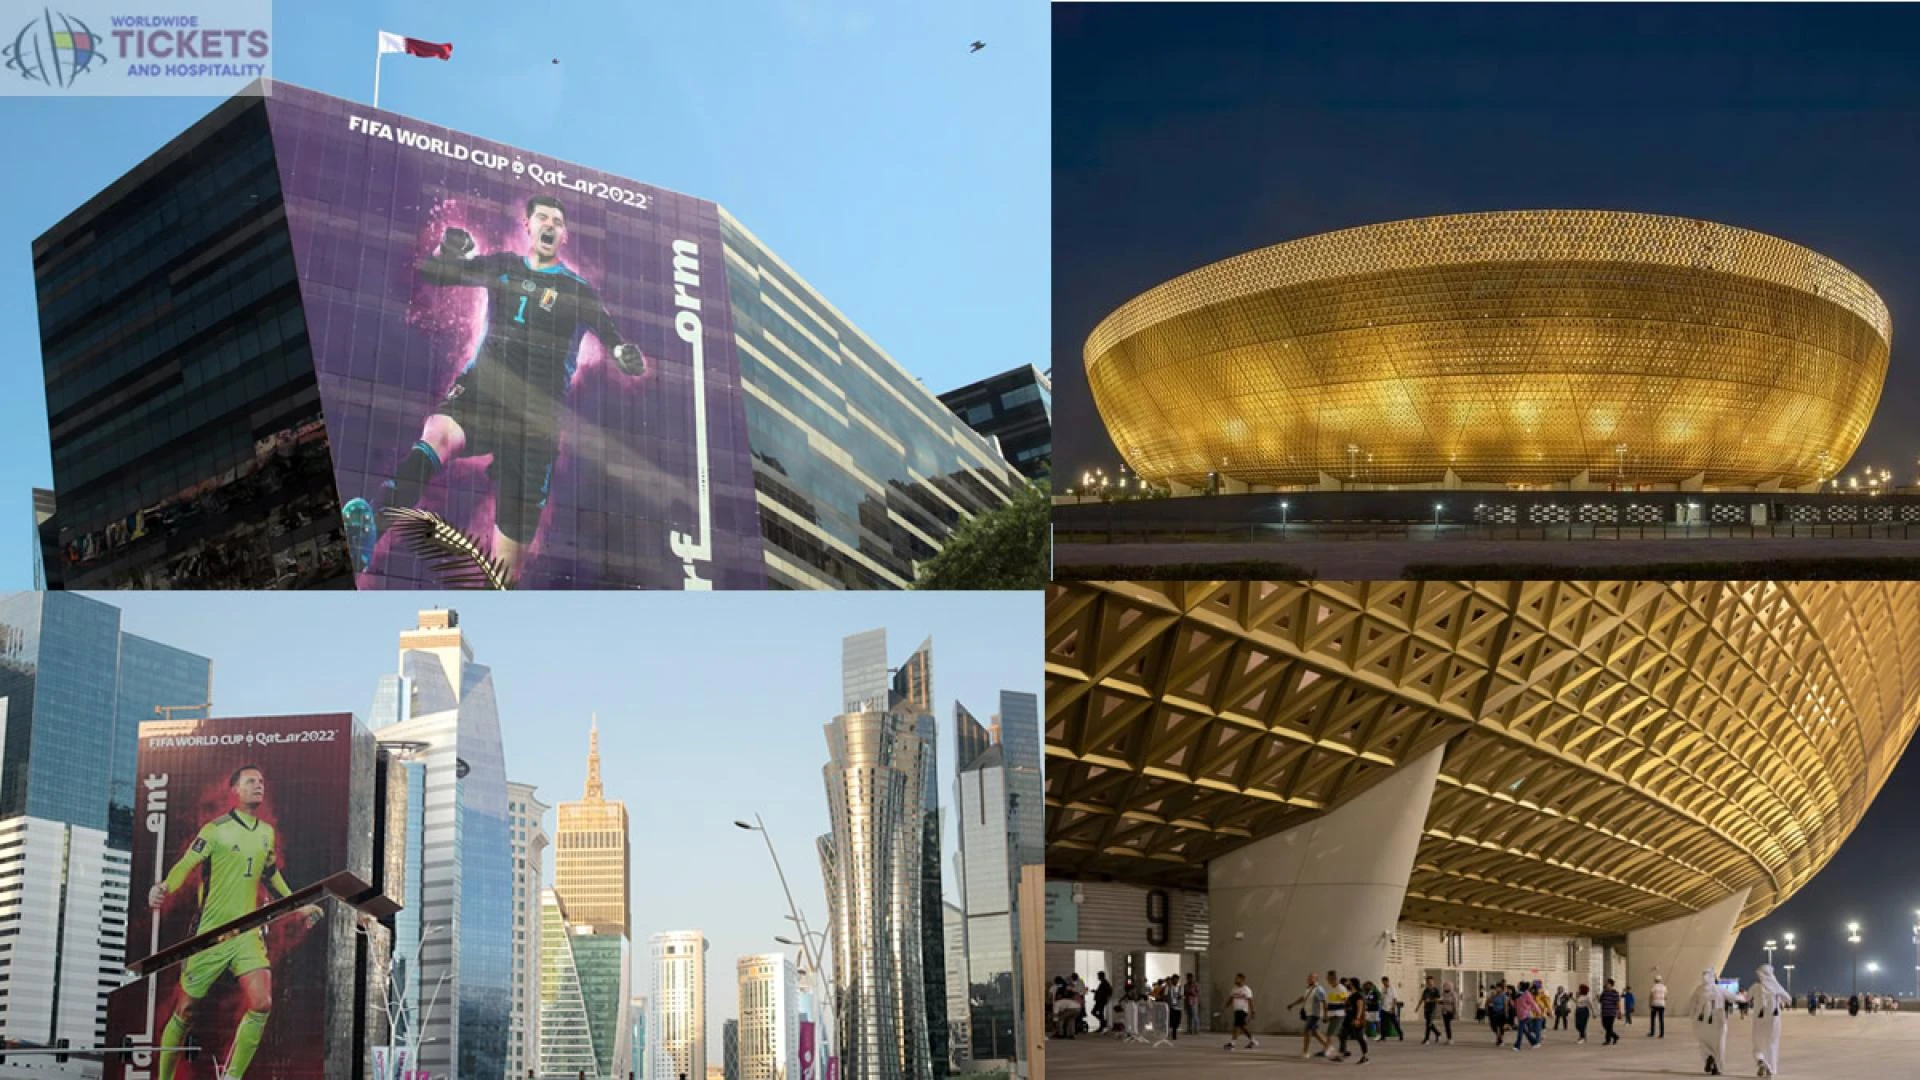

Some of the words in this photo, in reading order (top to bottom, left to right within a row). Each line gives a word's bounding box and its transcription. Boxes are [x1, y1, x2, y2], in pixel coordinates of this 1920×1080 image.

[348, 115, 394, 142] FIFA
[396, 128, 469, 160] WORLD
[471, 151, 509, 172] CUP
[150, 736, 175, 748] FIFA
[176, 735, 218, 747] WORLD
[221, 734, 243, 745] CUP
[1146, 889, 1168, 947] 9
